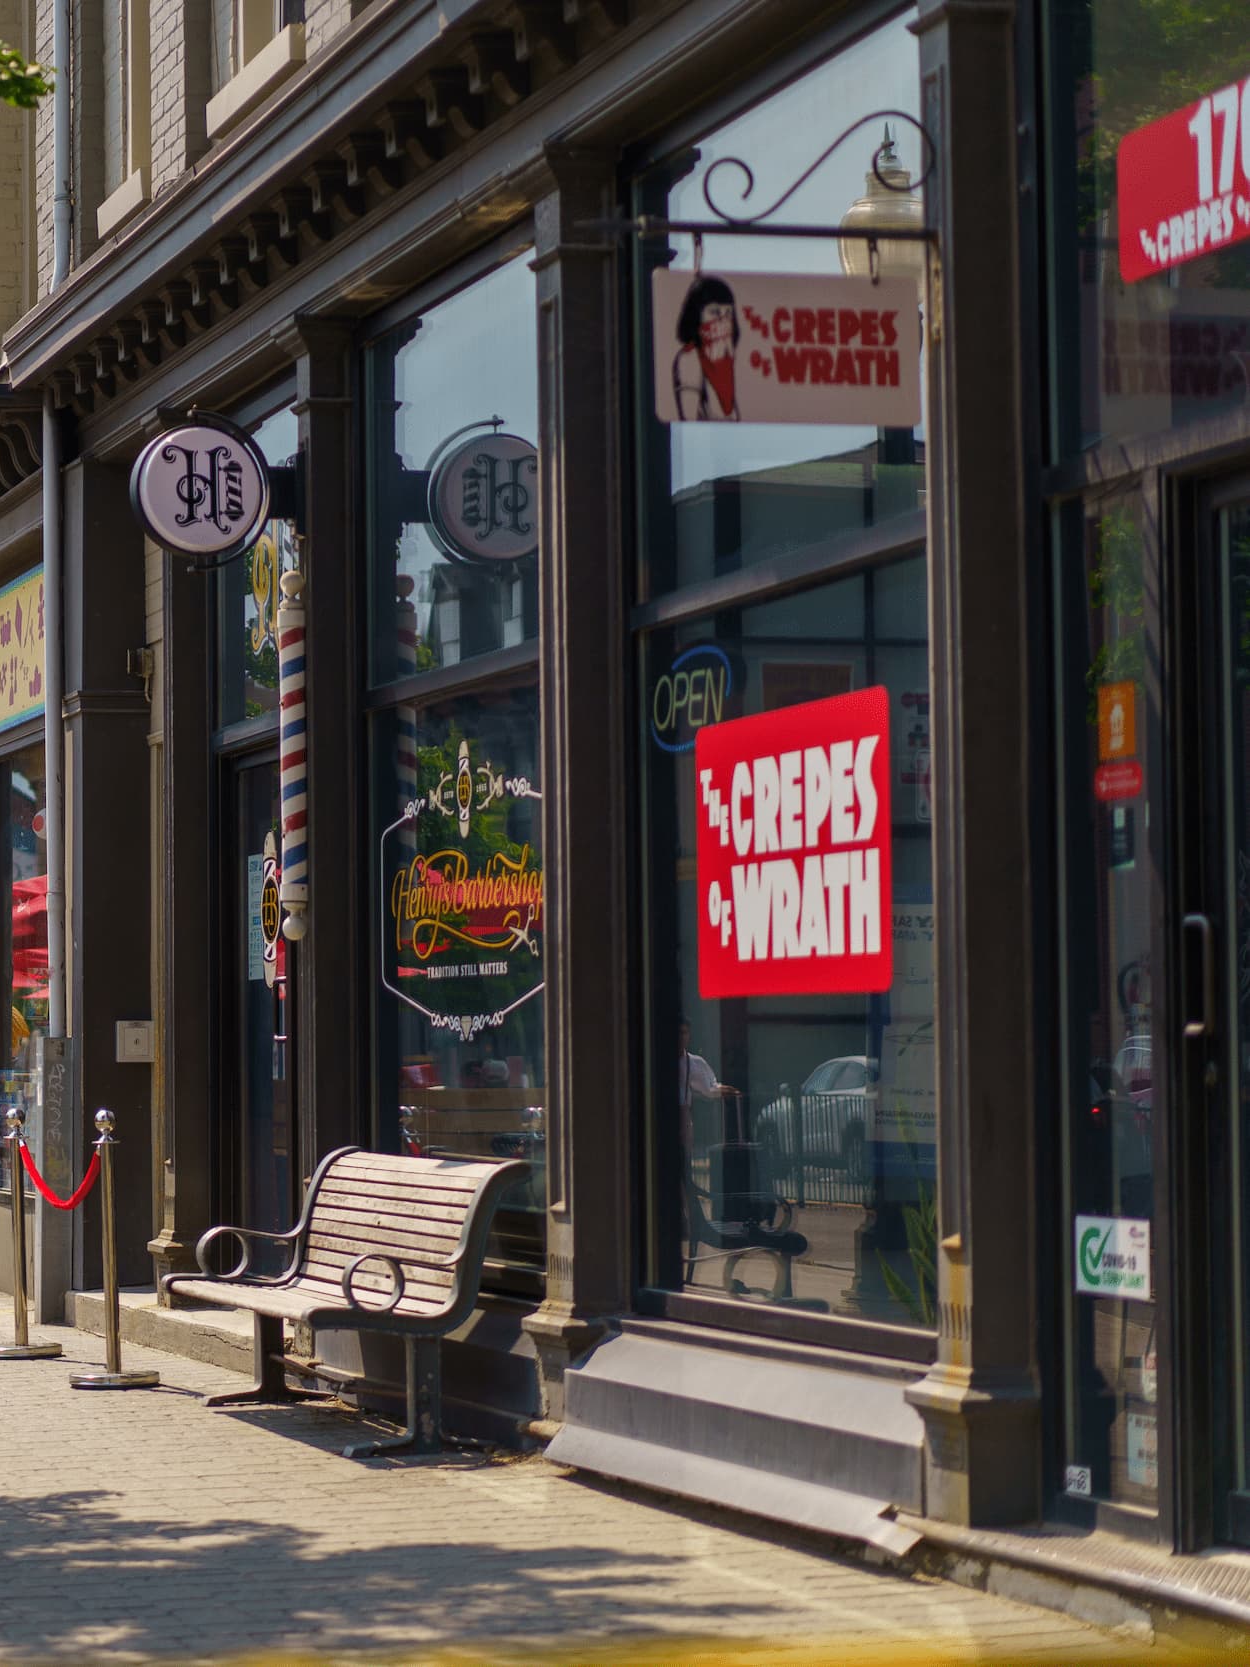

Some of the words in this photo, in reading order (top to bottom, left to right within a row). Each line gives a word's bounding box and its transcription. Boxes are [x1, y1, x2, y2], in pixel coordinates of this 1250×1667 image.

[1157, 193, 1234, 267] CREPES
[772, 307, 898, 347] CREPES
[772, 346, 899, 387] WRATH
[653, 667, 726, 731] OPEN
[700, 768, 730, 847] THE
[731, 735, 880, 856] CREPES
[708, 881, 732, 948] OF
[731, 848, 881, 962] WRATH
[427, 965, 459, 979] TRADITION
[461, 964, 477, 976] STILL
[479, 961, 508, 975] MATTERS
